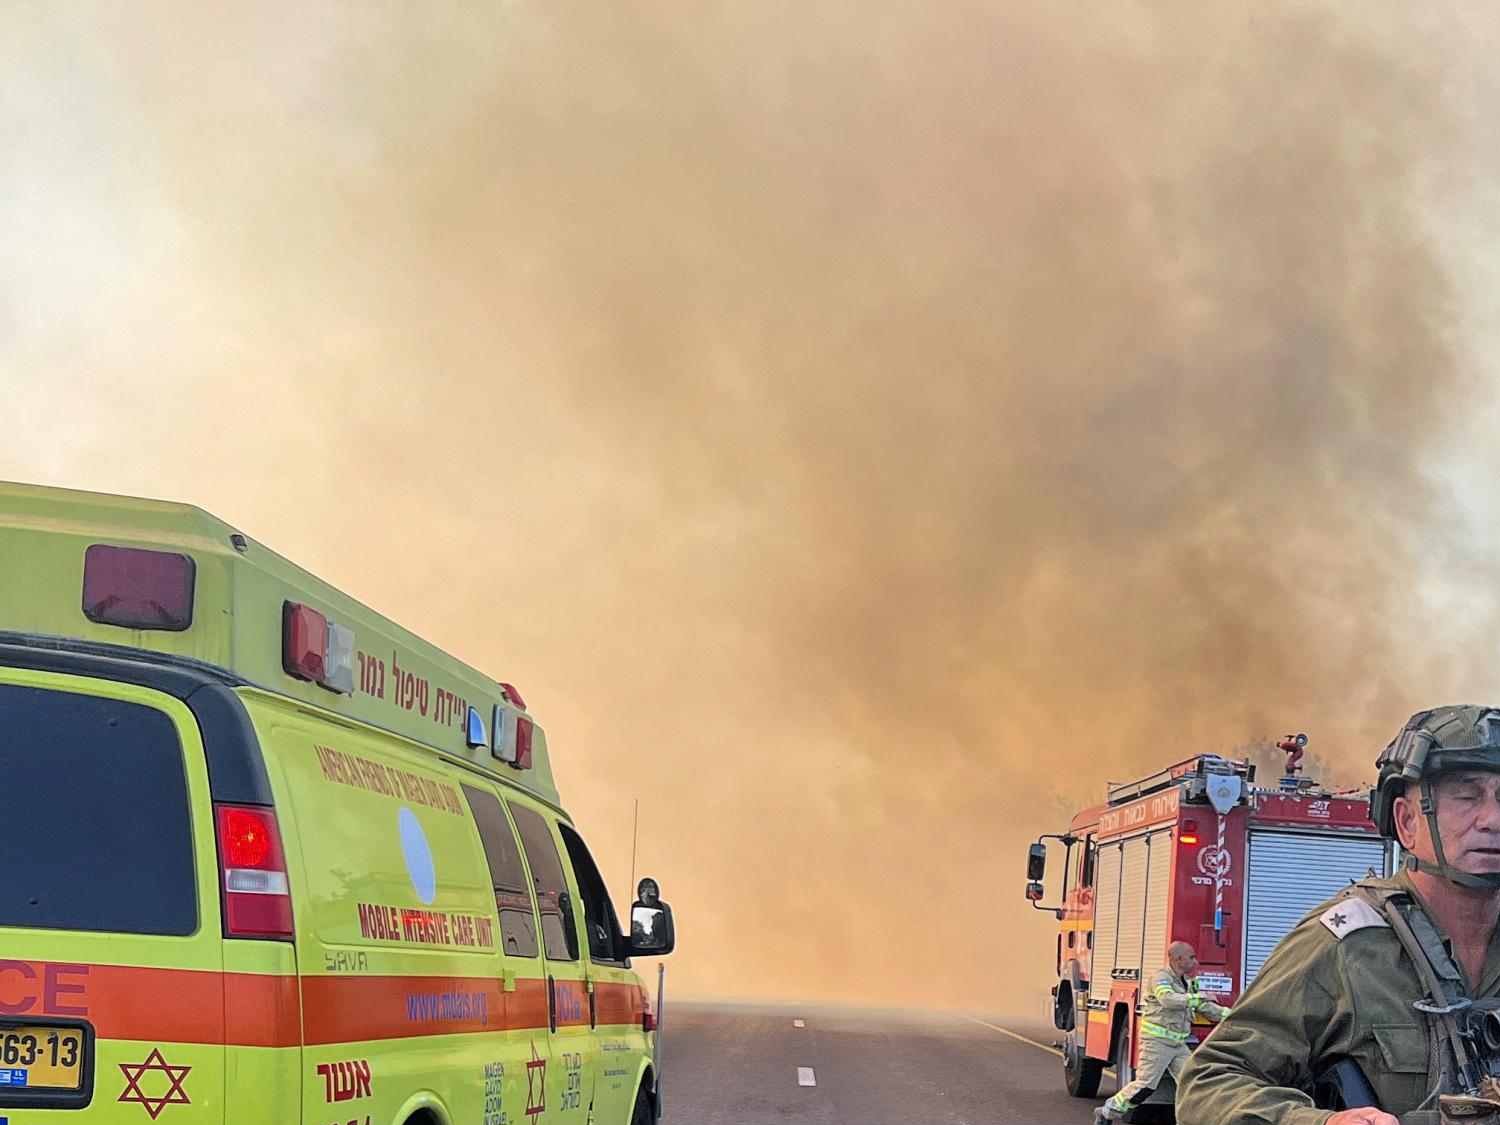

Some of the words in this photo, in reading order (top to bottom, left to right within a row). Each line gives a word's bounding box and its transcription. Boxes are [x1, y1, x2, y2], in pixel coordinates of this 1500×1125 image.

[348, 651, 385, 699] נמר
[392, 650, 429, 717] טיפול
[434, 687, 468, 733] ניידת
[357, 903, 401, 941] MOBILE
[400, 908, 450, 945] INTENSIVE
[451, 914, 475, 947] CARE
[475, 916, 494, 948] UNIT
[0, 1034, 78, 1067] 63-13
[484, 1062, 504, 1079] MAGEN
[316, 1060, 372, 1103] אשר
[485, 1079, 502, 1098] DAVID
[485, 1096, 503, 1114] ADOM
